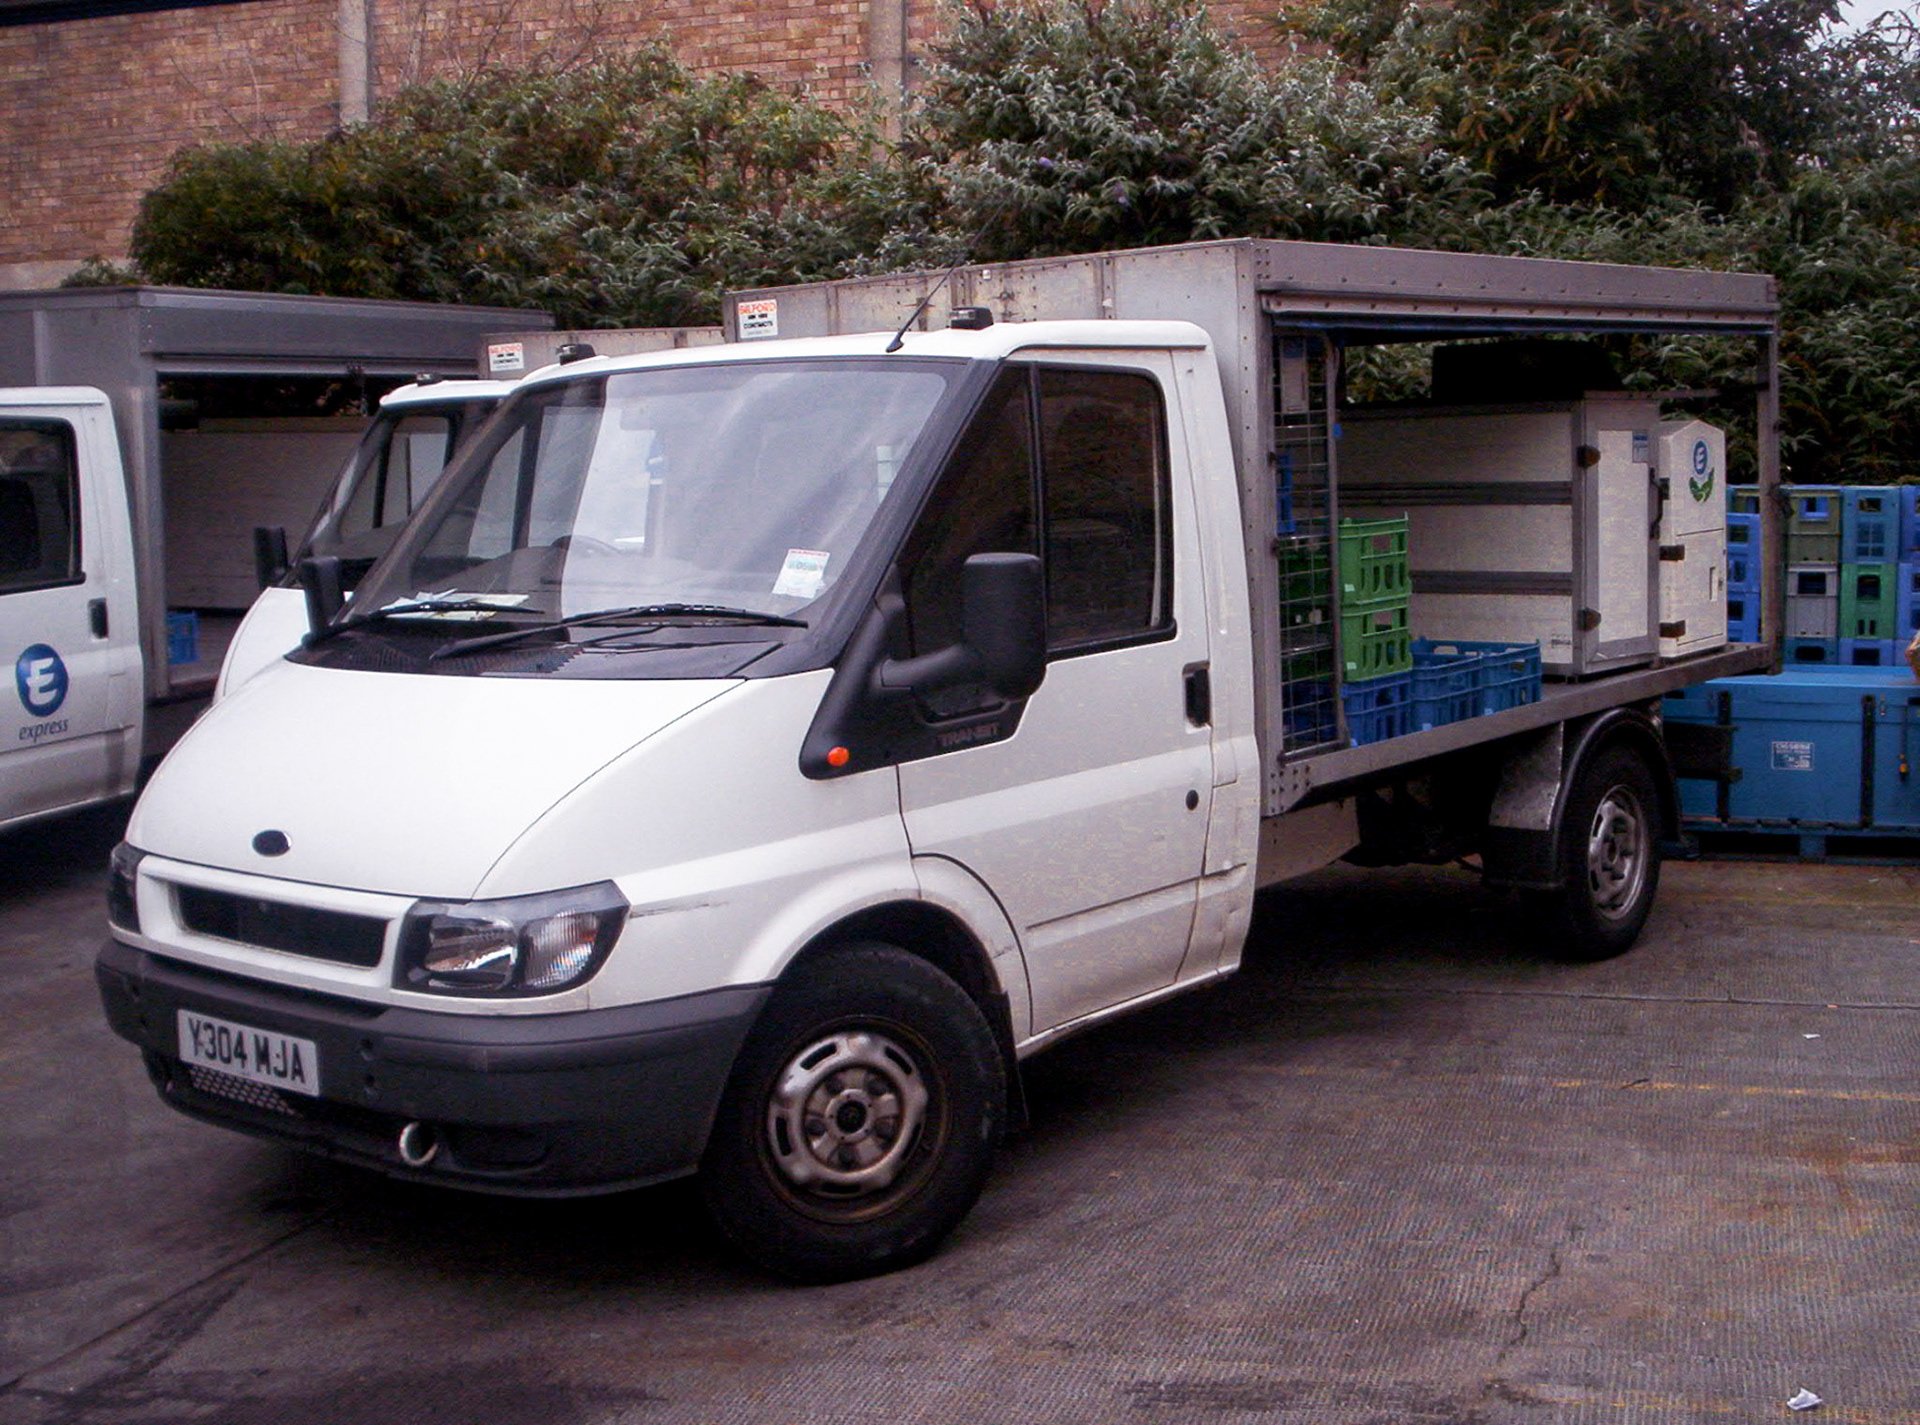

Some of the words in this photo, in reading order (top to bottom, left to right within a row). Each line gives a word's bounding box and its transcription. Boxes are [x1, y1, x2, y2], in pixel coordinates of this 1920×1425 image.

[26, 657, 56, 705] E
[19, 719, 68, 743] express
[188, 1018, 247, 1069] Y304
[253, 1034, 306, 1084] MJA
